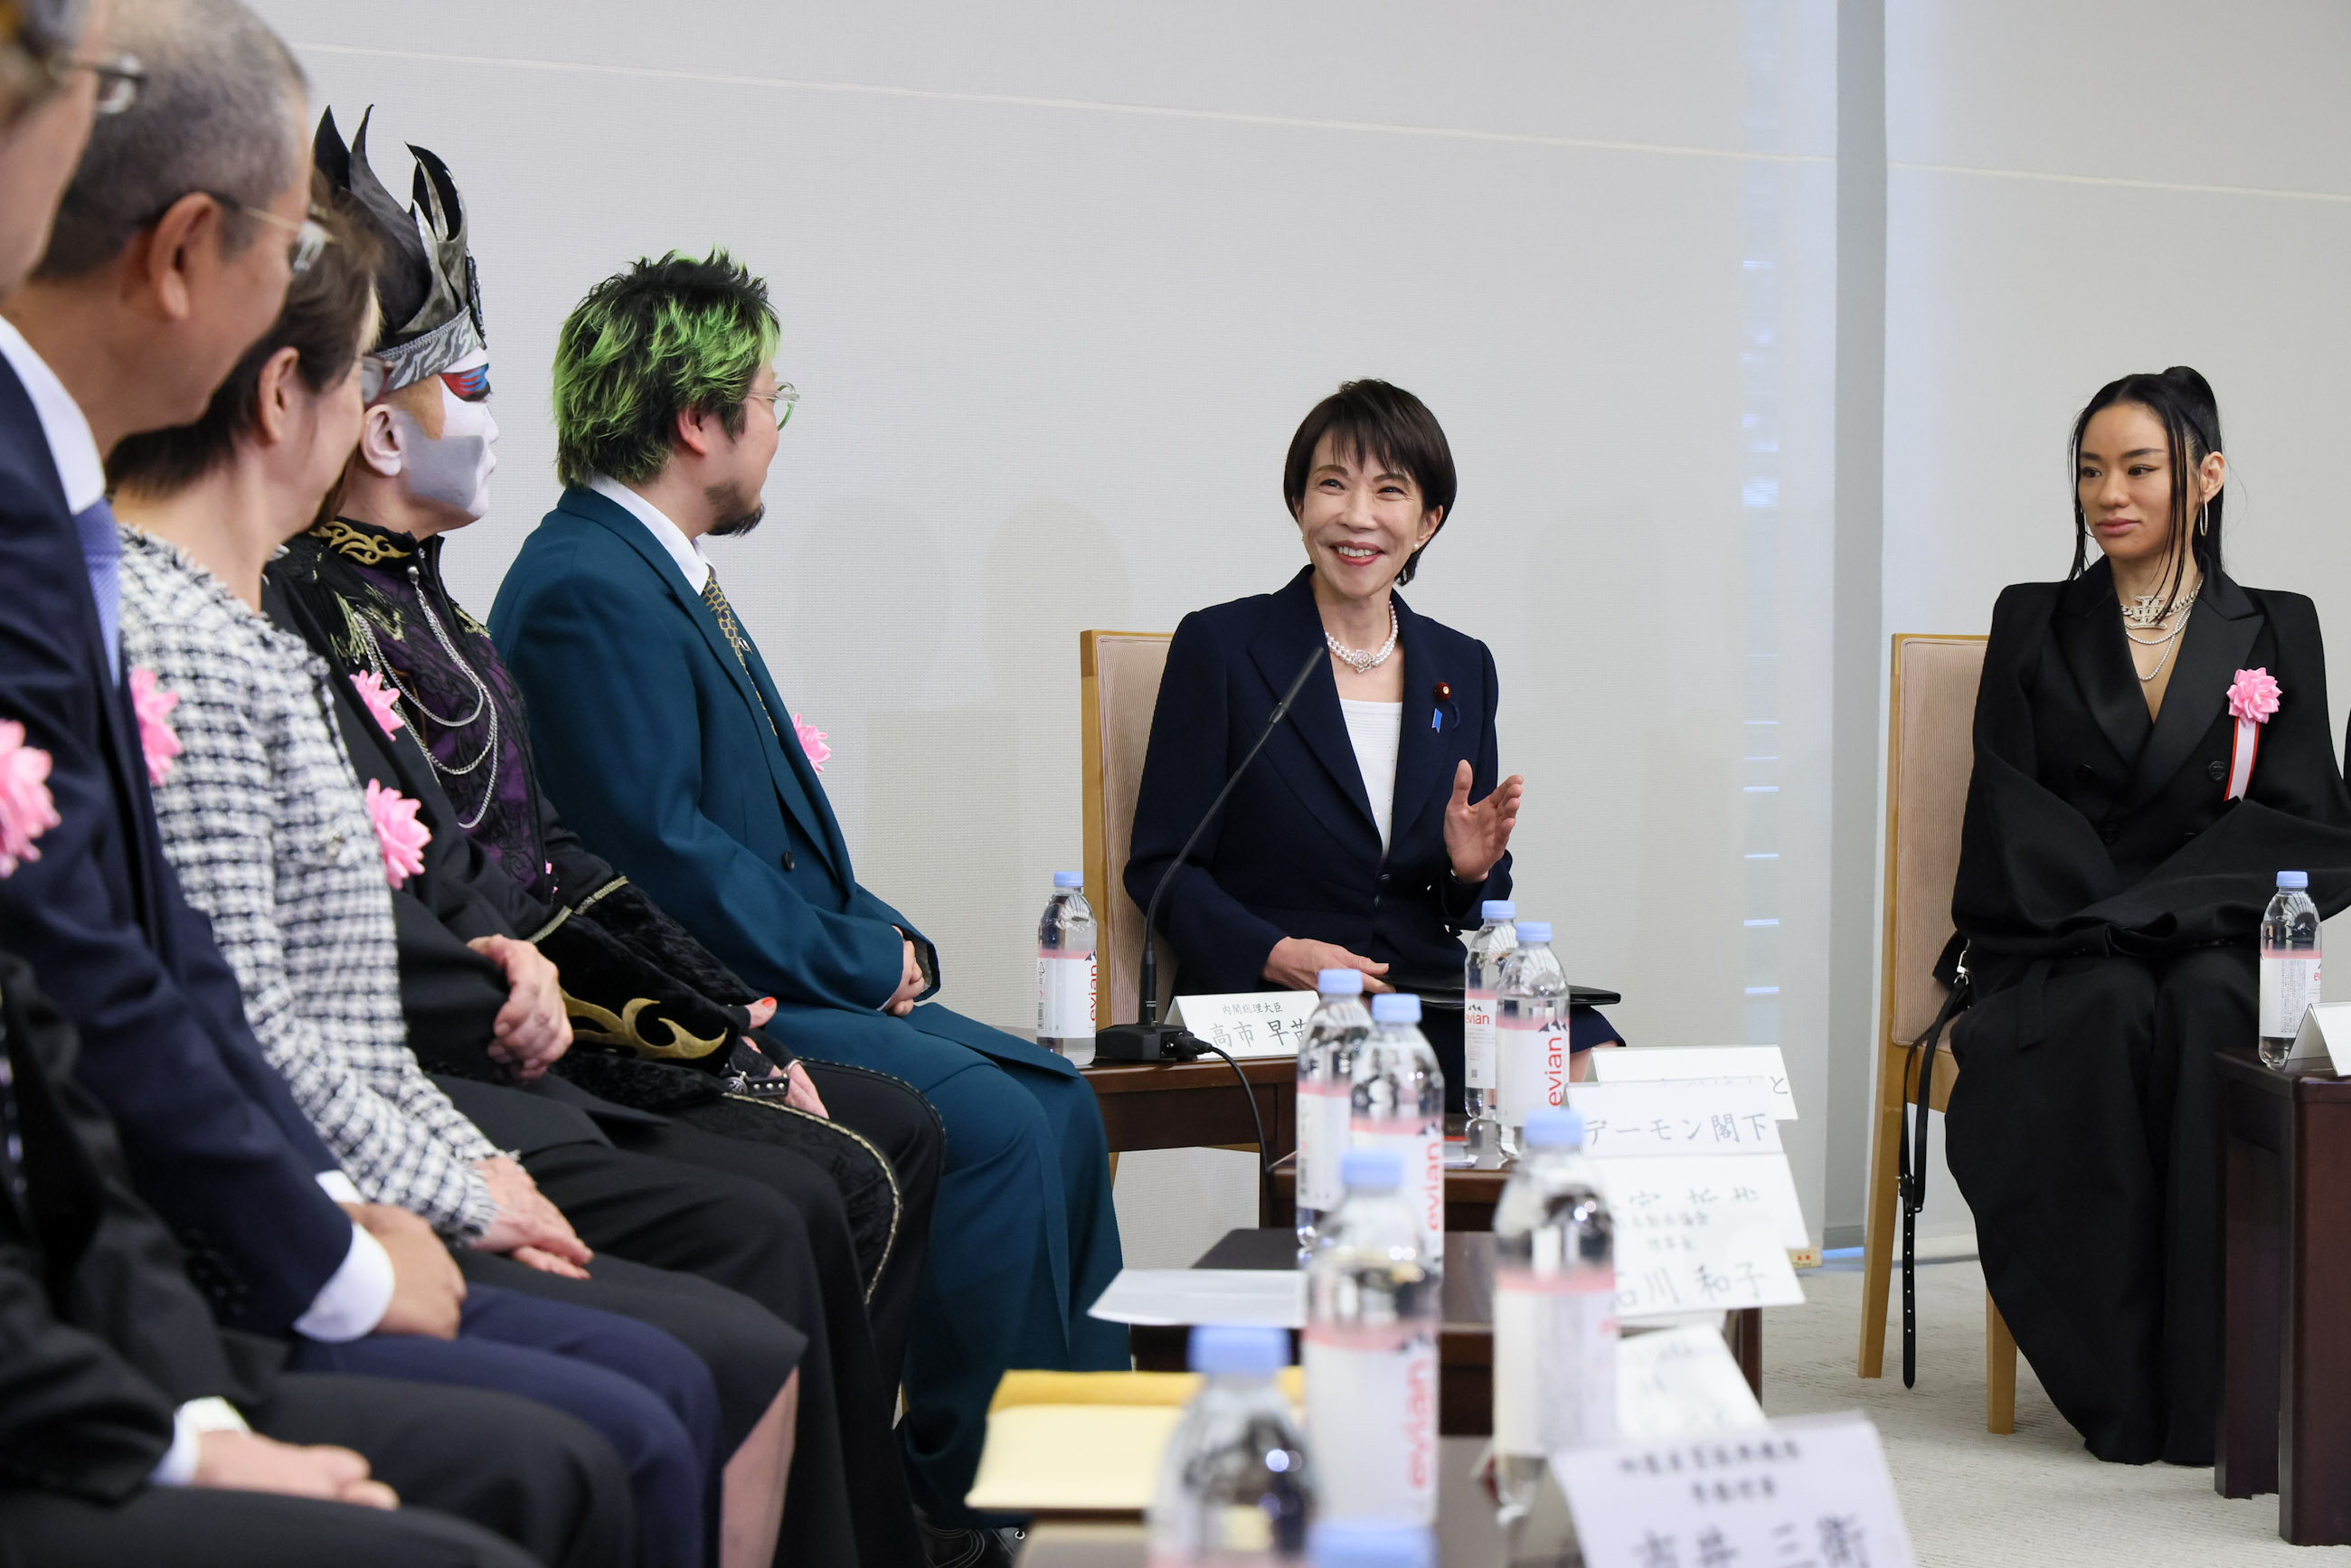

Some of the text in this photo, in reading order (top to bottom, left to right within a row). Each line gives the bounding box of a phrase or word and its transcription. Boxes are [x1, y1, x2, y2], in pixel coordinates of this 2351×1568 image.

[1222, 1001, 1283, 1014] 内閣総理大臣
[1544, 1036, 1563, 1106] evian
[1585, 1112, 1766, 1146] デーモン閣下
[1425, 1142, 1441, 1231] evian
